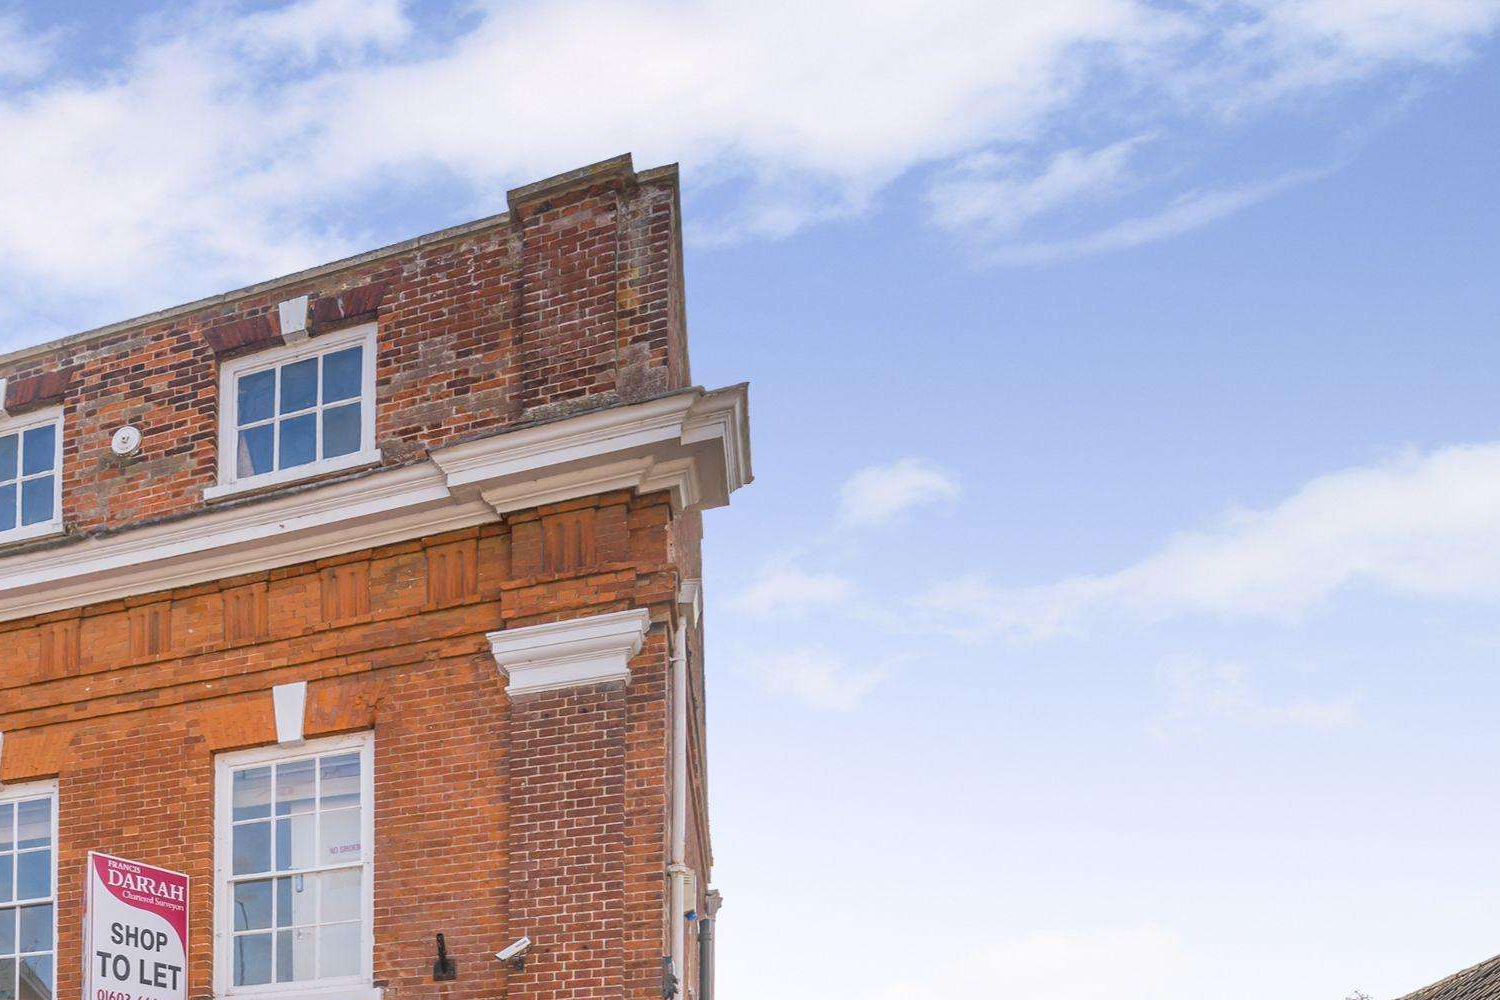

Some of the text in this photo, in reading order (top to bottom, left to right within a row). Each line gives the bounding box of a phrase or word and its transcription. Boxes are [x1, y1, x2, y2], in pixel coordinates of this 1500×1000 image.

[107, 859, 141, 874] FRANCIS
[107, 868, 185, 902] DARRAH
[122, 890, 154, 905] Chartered
[111, 922, 168, 952] SHOP
[96, 951, 182, 991] TO LET
